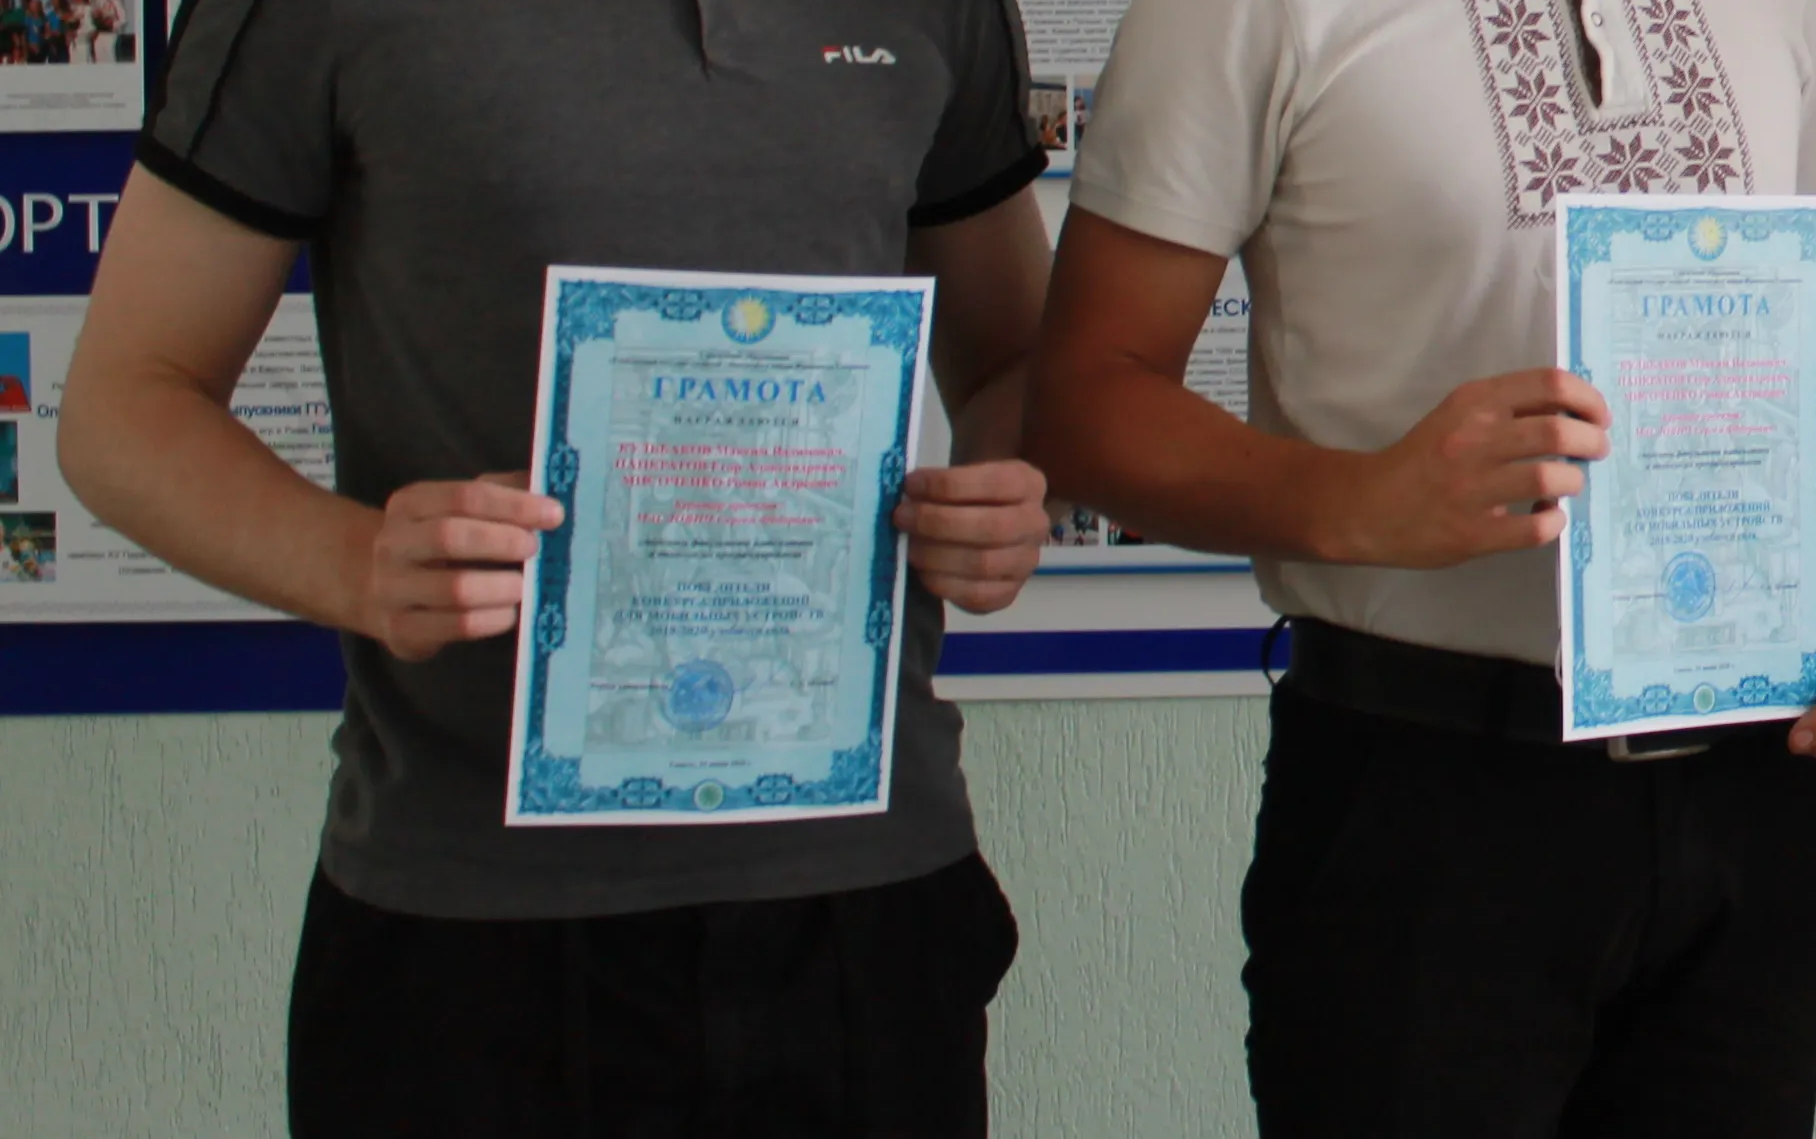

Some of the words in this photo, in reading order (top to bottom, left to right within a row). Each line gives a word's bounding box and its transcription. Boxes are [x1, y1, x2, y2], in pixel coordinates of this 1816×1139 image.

[822, 45, 896, 64] FILA
[0, 193, 119, 253] РТ
[1642, 293, 1772, 317] ГРАМОТА
[652, 375, 827, 404] ГРАМОТА
